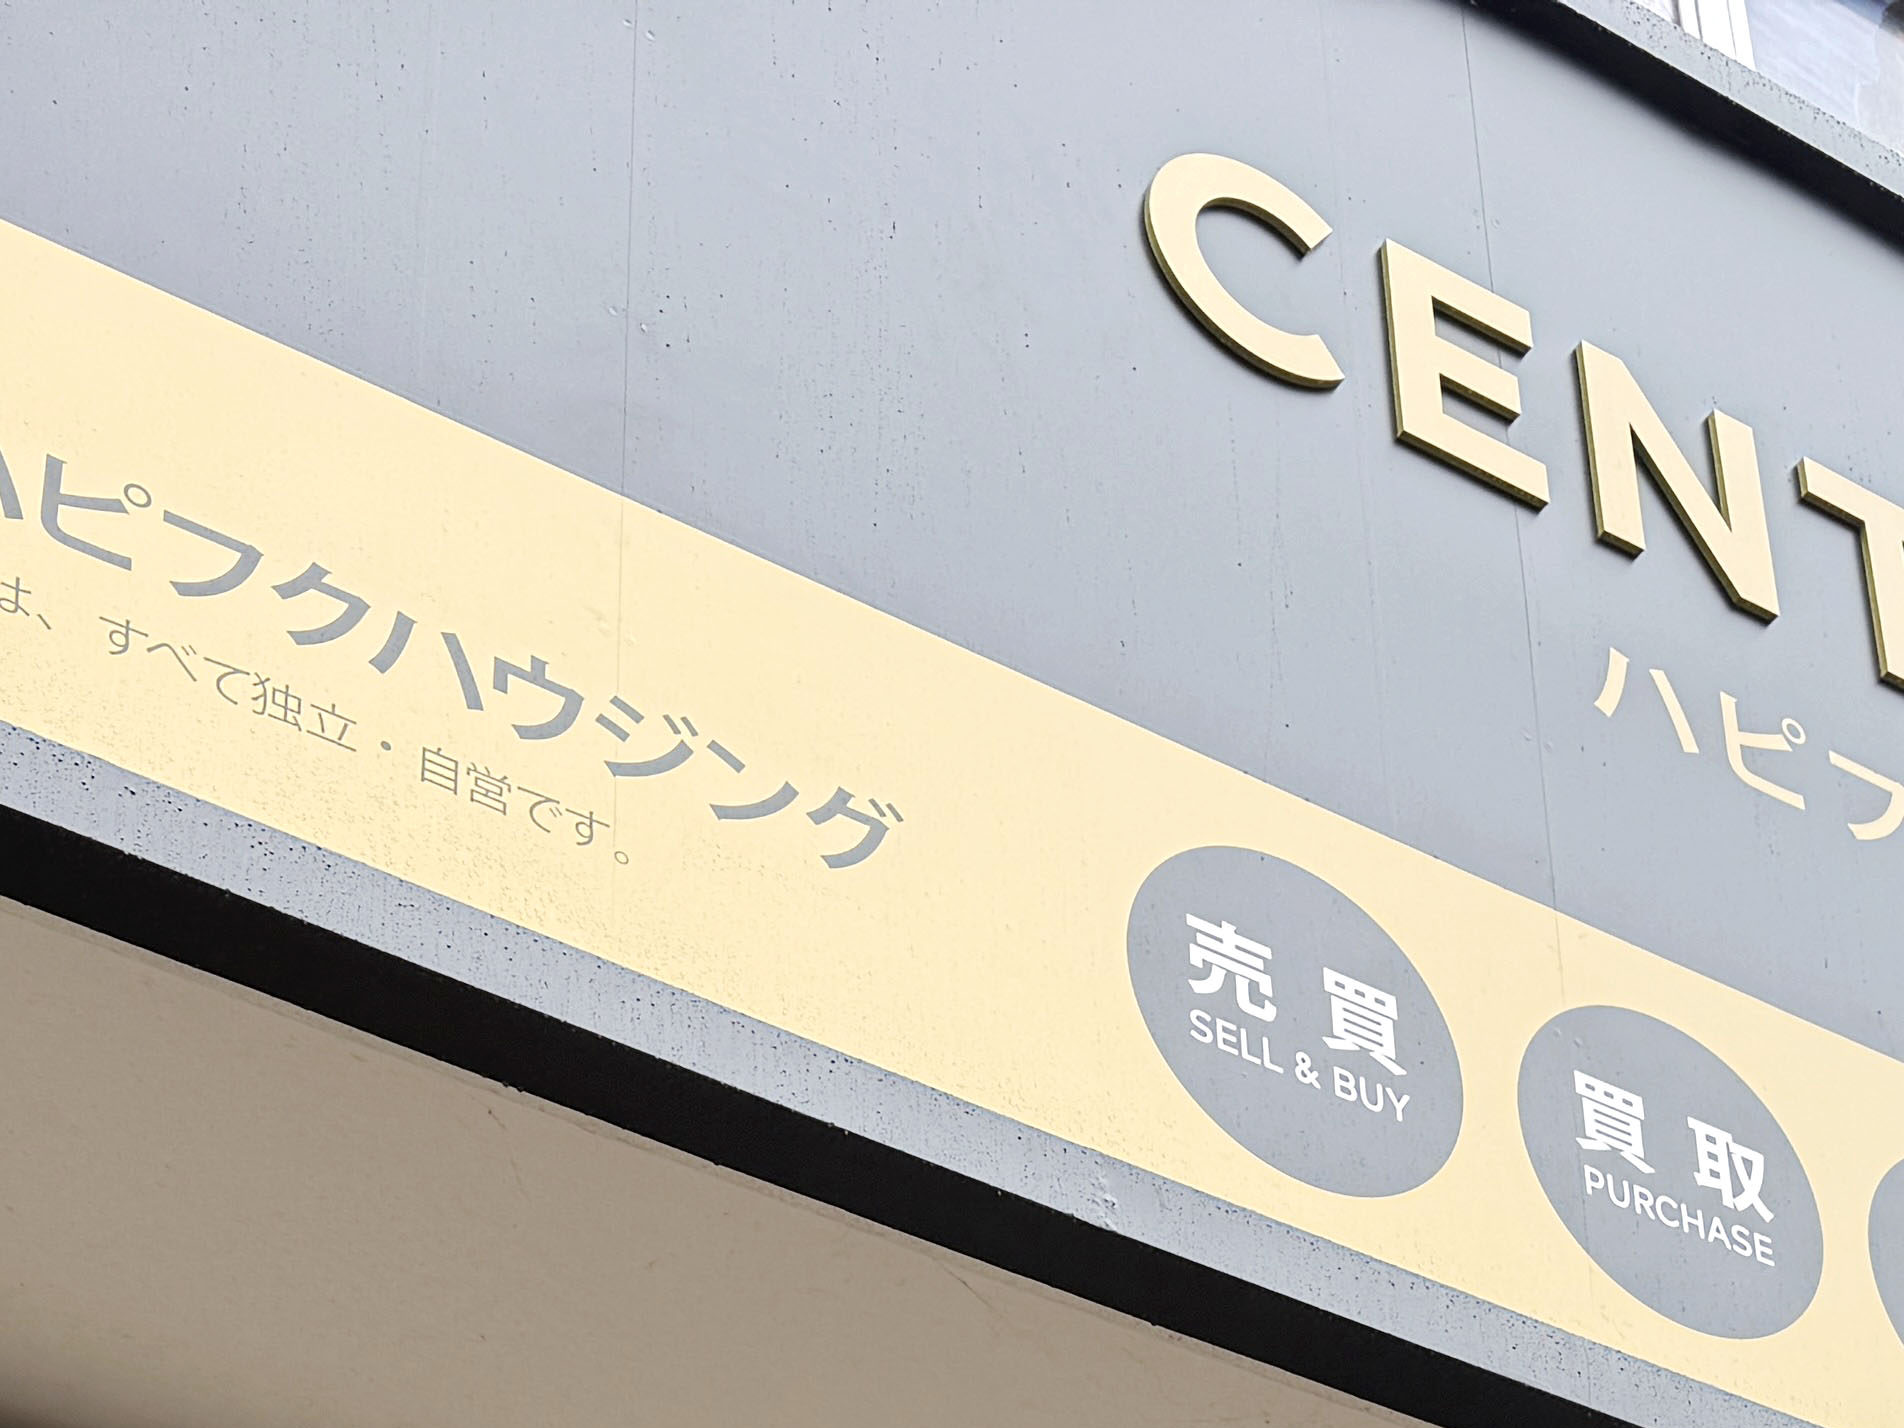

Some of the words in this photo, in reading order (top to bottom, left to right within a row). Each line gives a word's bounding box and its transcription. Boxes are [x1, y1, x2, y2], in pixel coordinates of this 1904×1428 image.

[1188, 1009, 1284, 1077] SELL
[1294, 1049, 1323, 1091] &
[1332, 1065, 1412, 1123] BUY
[1583, 1164, 1777, 1268] PURCHASE
